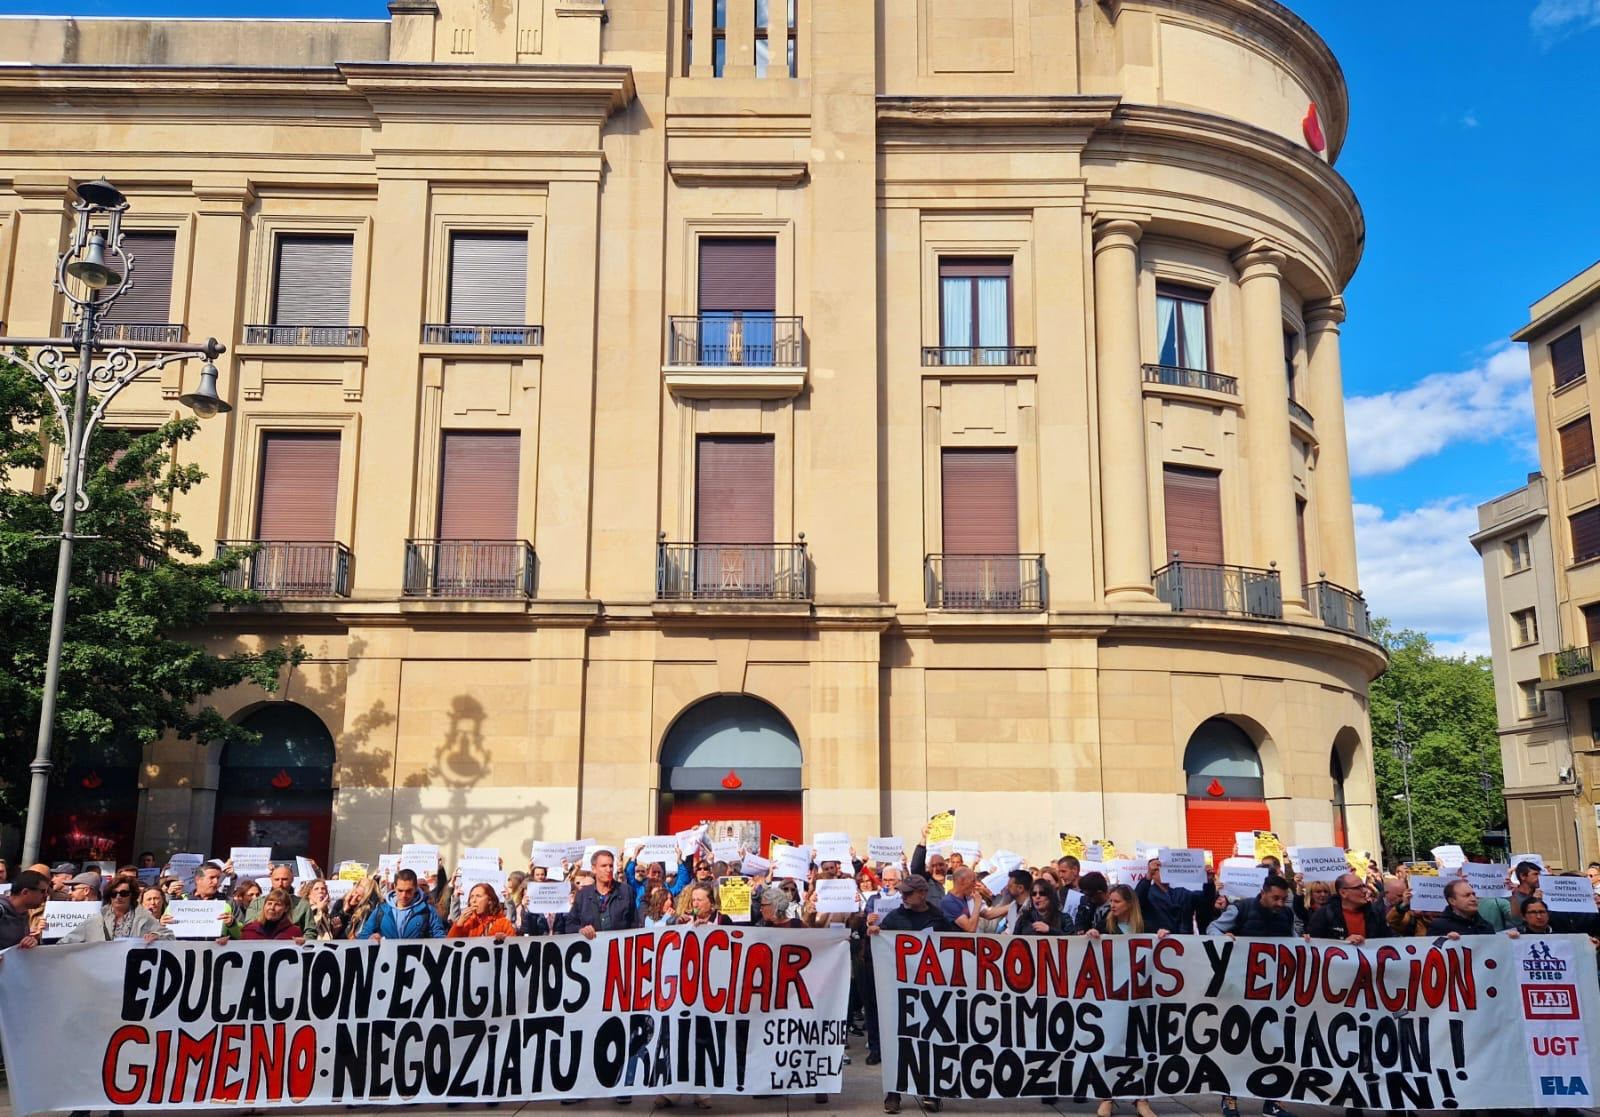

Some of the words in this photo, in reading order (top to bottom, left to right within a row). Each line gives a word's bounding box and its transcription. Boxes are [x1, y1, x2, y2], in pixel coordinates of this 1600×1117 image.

[1301, 857, 1346, 865] PATRONALES
[386, 939, 591, 1019] EXIGIMOS
[602, 930, 813, 1014] NEGOCIAR
[895, 933, 1184, 1001] PATRONALES
[1202, 940, 1234, 998] Y
[1523, 960, 1566, 971] SEPNA
[1529, 971, 1554, 981] FSIE
[1531, 992, 1569, 1007] LAB
[897, 988, 1105, 1054] EXIGIMOS
[1533, 1036, 1580, 1056] UGT
[331, 1015, 583, 1103] NEGOZIATU
[775, 1049, 816, 1069] UGT
[896, 1037, 1231, 1099] NEGOZIAZIOA
[770, 1070, 818, 1090] LAB
[1540, 1075, 1590, 1096] ELA
